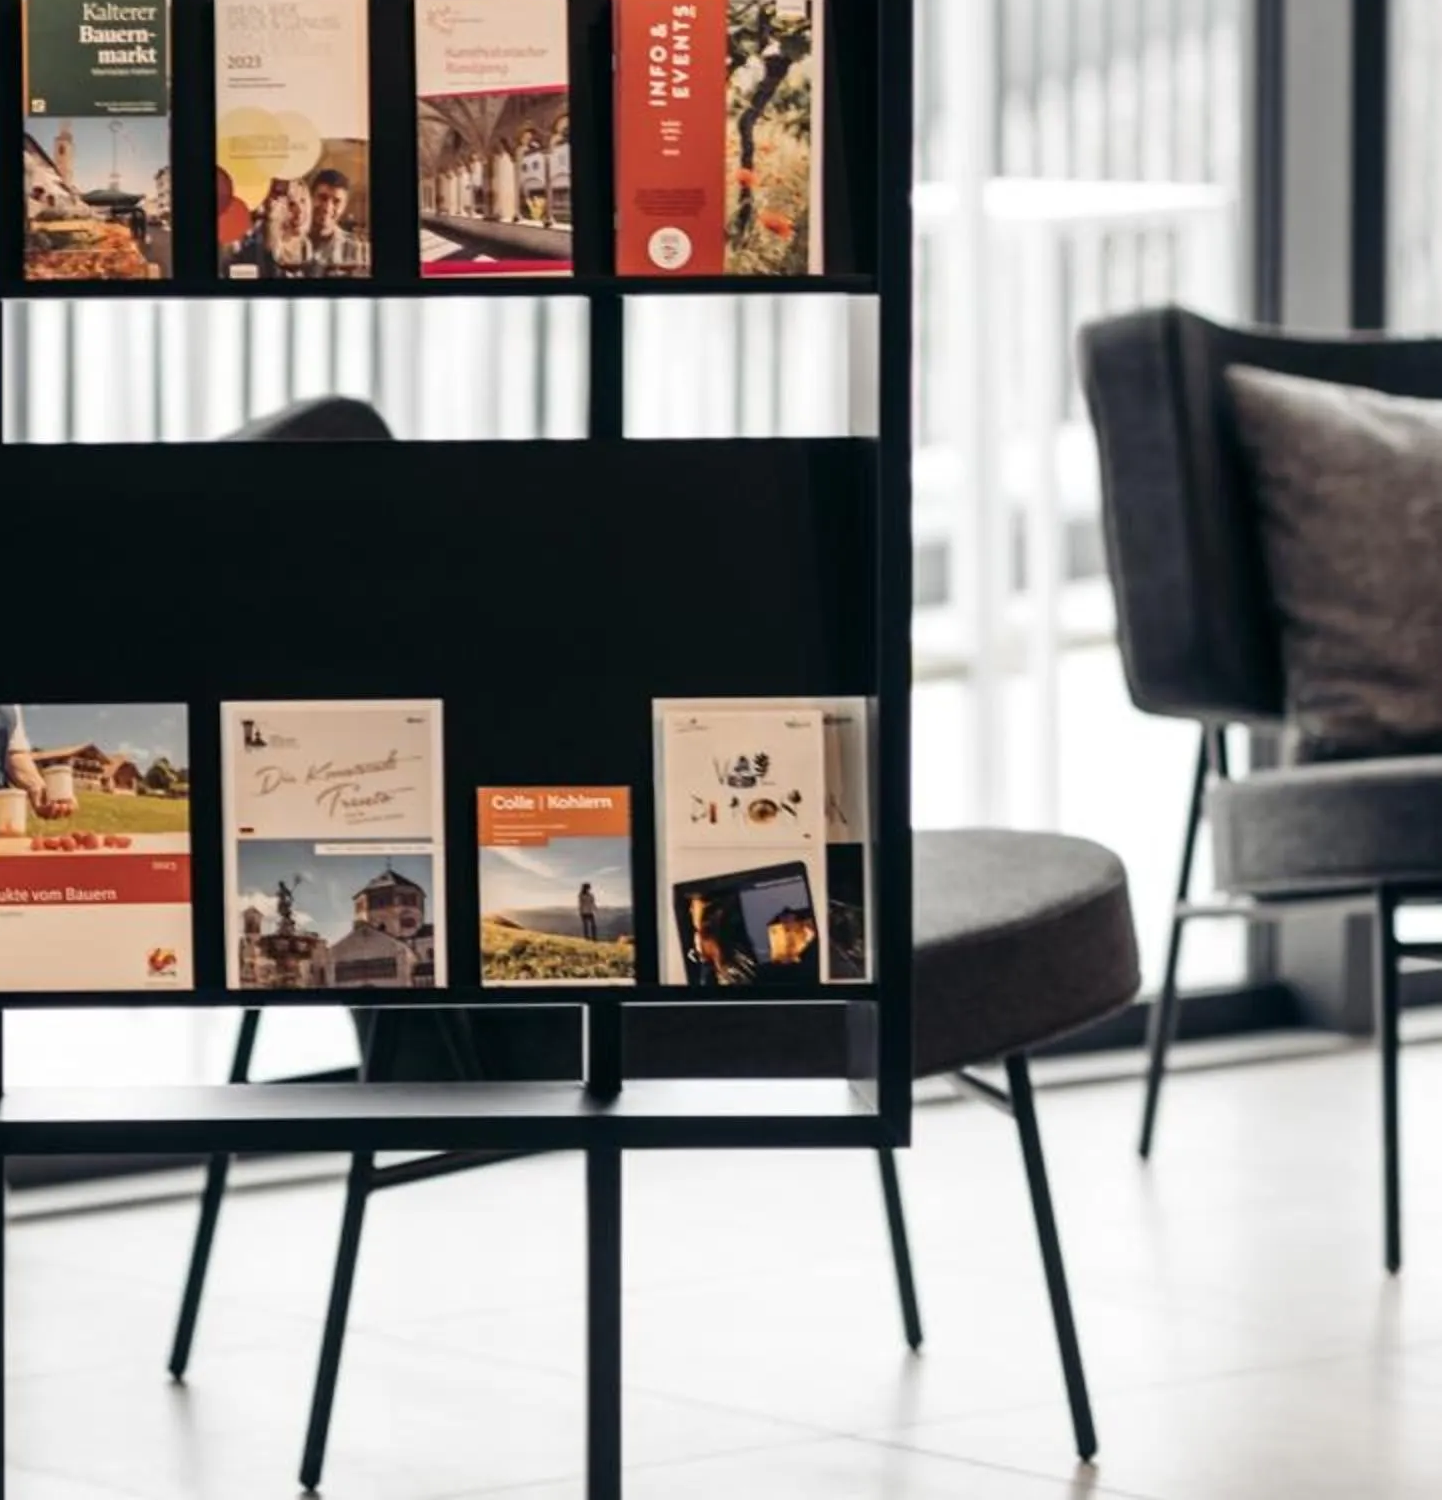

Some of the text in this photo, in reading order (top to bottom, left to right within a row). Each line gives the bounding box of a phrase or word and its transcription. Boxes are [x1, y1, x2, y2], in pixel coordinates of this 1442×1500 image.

[82, 2, 158, 22] Kalterer
[78, 25, 157, 44] Bauern-
[98, 47, 157, 64] markt
[671, 4, 695, 99] EVENTS
[227, 55, 263, 70] 2023
[649, 23, 668, 107] INFO &
[491, 794, 613, 810] Colle Kohlern
[32, 890, 62, 901] vom
[66, 887, 117, 901] Bauern
